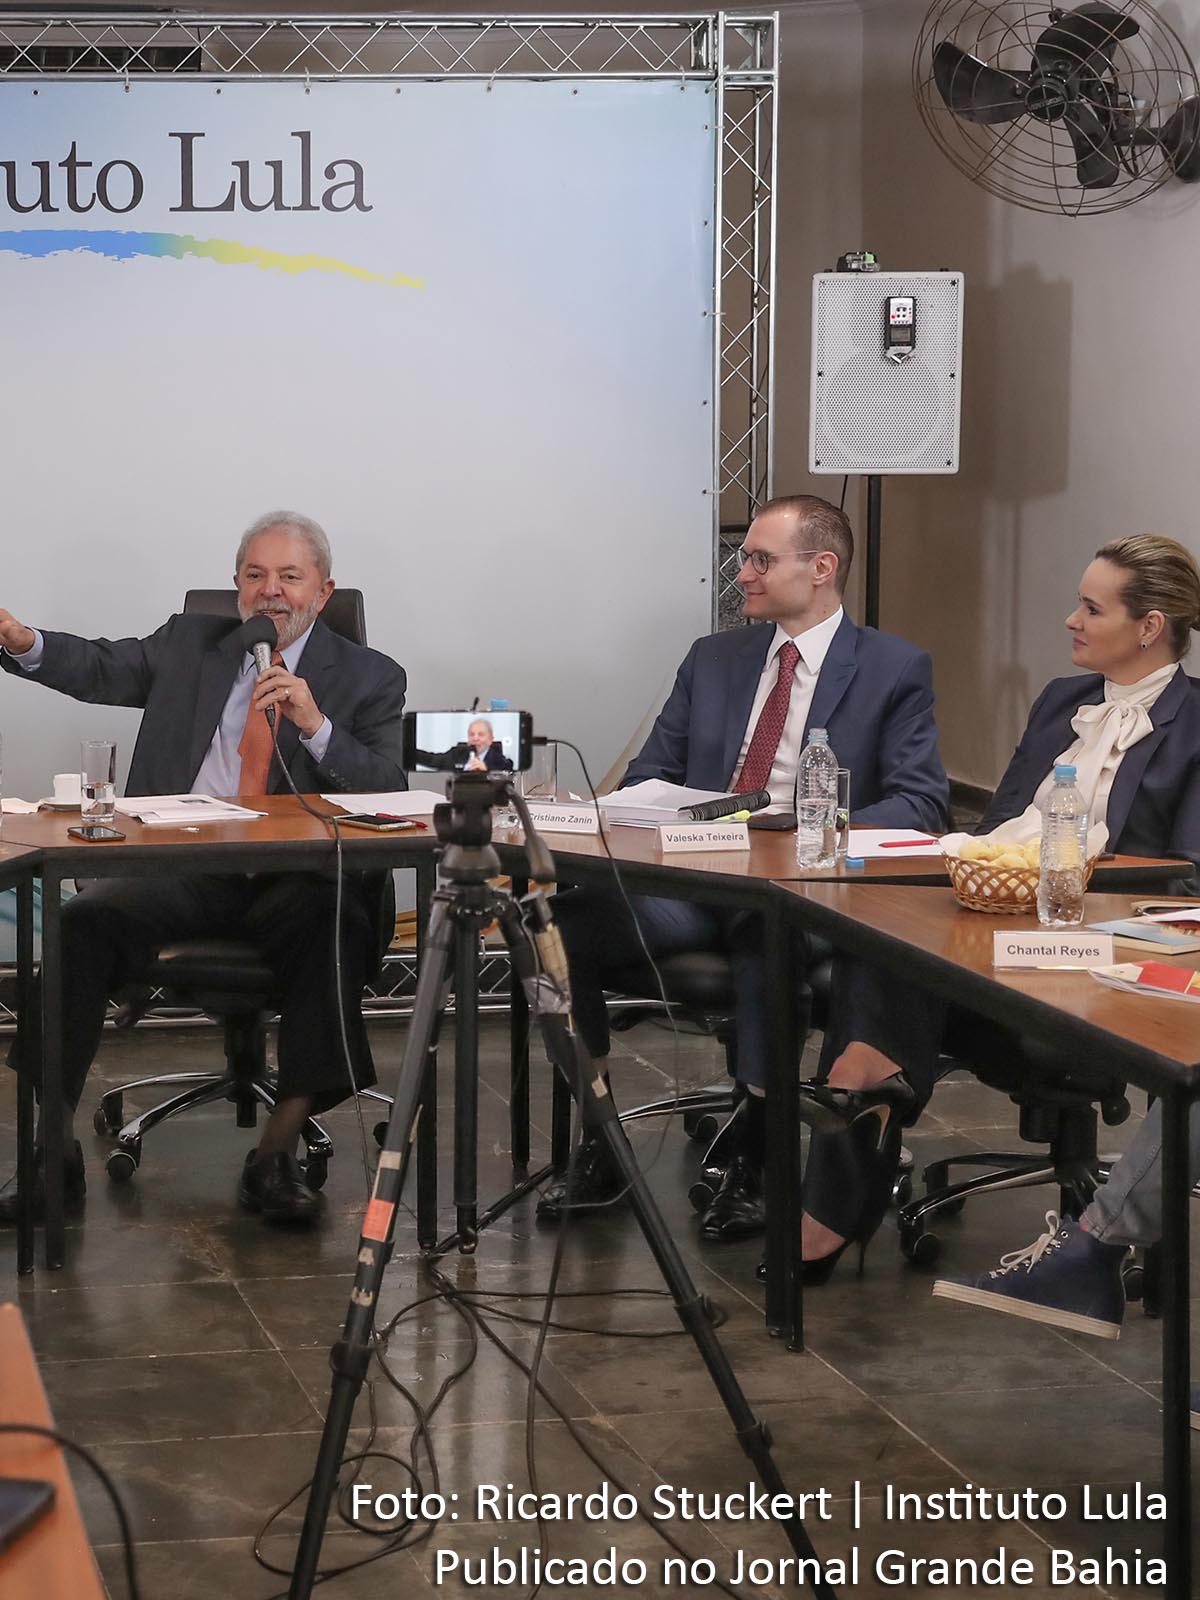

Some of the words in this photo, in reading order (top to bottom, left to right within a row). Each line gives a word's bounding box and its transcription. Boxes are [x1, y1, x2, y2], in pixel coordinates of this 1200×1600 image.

[168, 130, 373, 213] Lula
[568, 815, 593, 825] Zanin
[666, 833, 704, 843] Valeska
[706, 832, 744, 842] Teixeira
[1007, 944, 1056, 956] Chantal
[1060, 945, 1100, 958] Reyes
